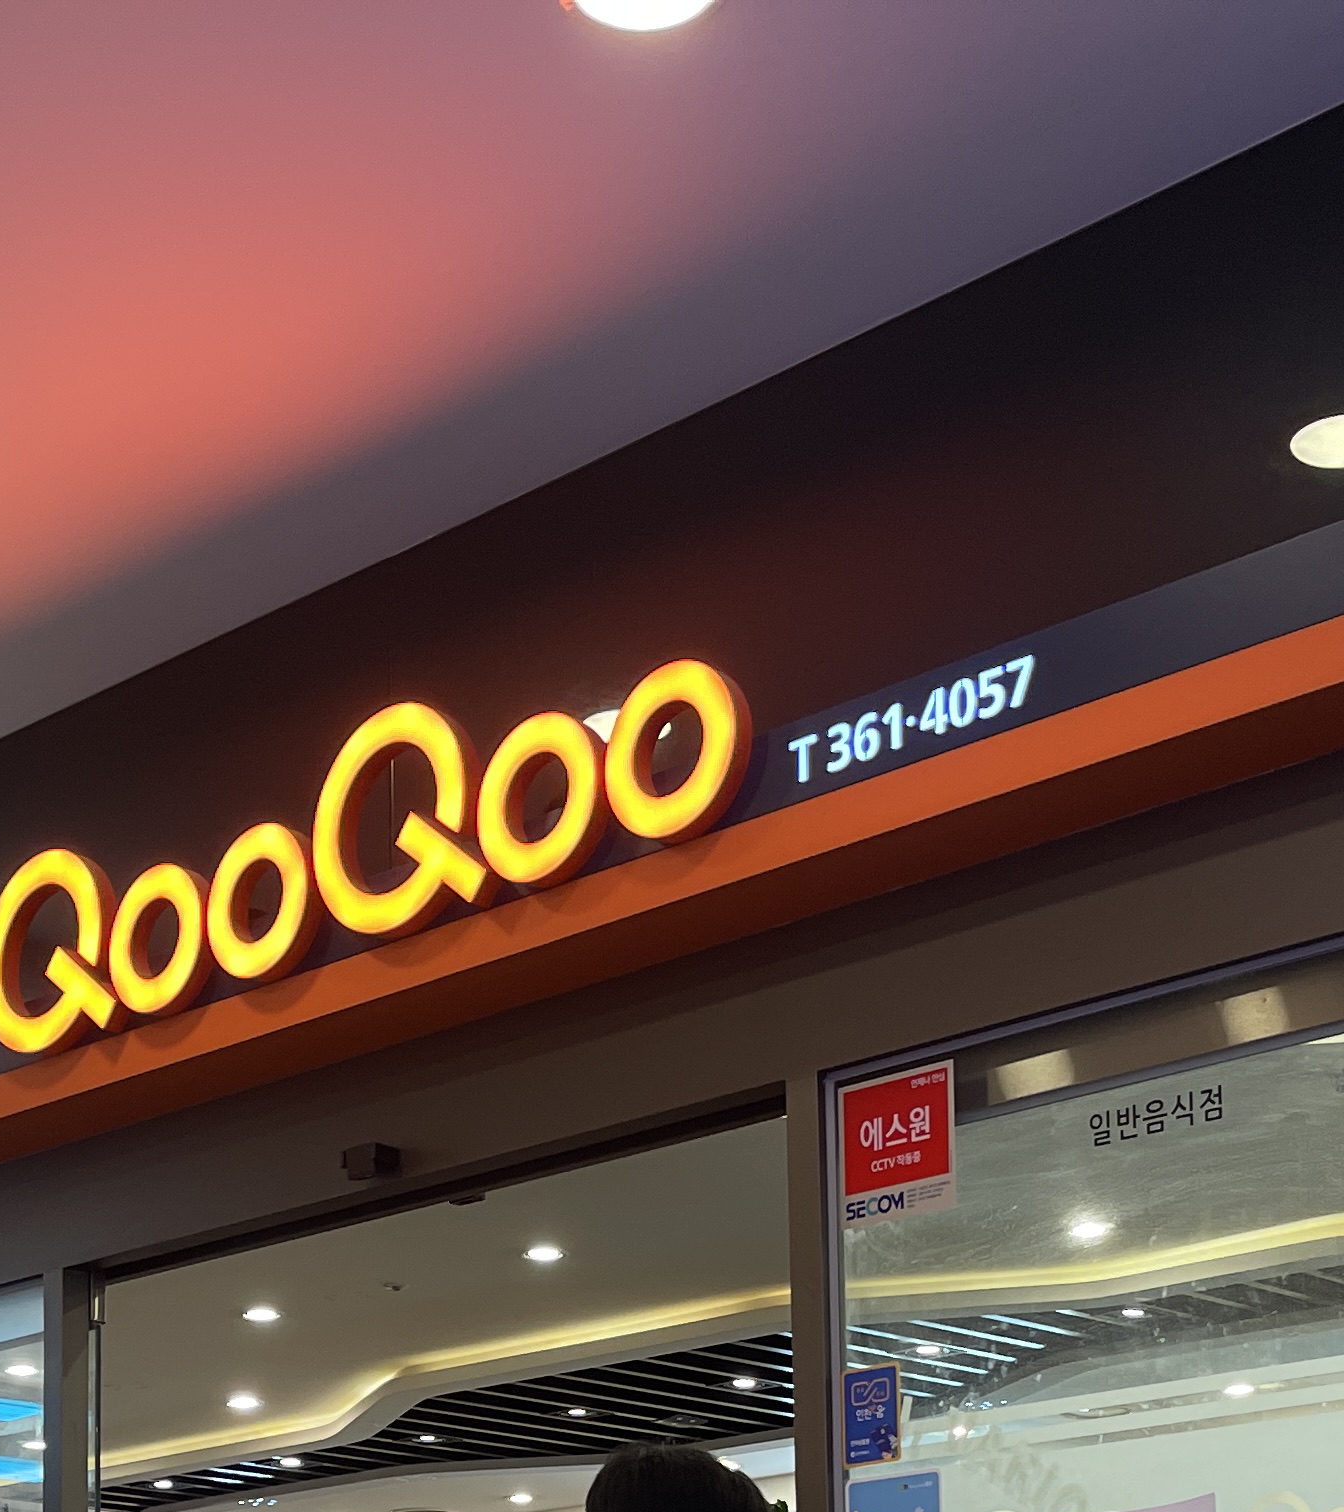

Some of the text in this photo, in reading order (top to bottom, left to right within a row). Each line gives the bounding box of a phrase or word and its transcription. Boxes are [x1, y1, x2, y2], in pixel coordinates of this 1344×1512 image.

[787, 733, 819, 783] T
[859, 1104, 932, 1152] 에스원
[1089, 1084, 1224, 1148] 일반음식점
[870, 1157, 896, 1173] CCTV
[845, 1191, 906, 1222] SECOM
